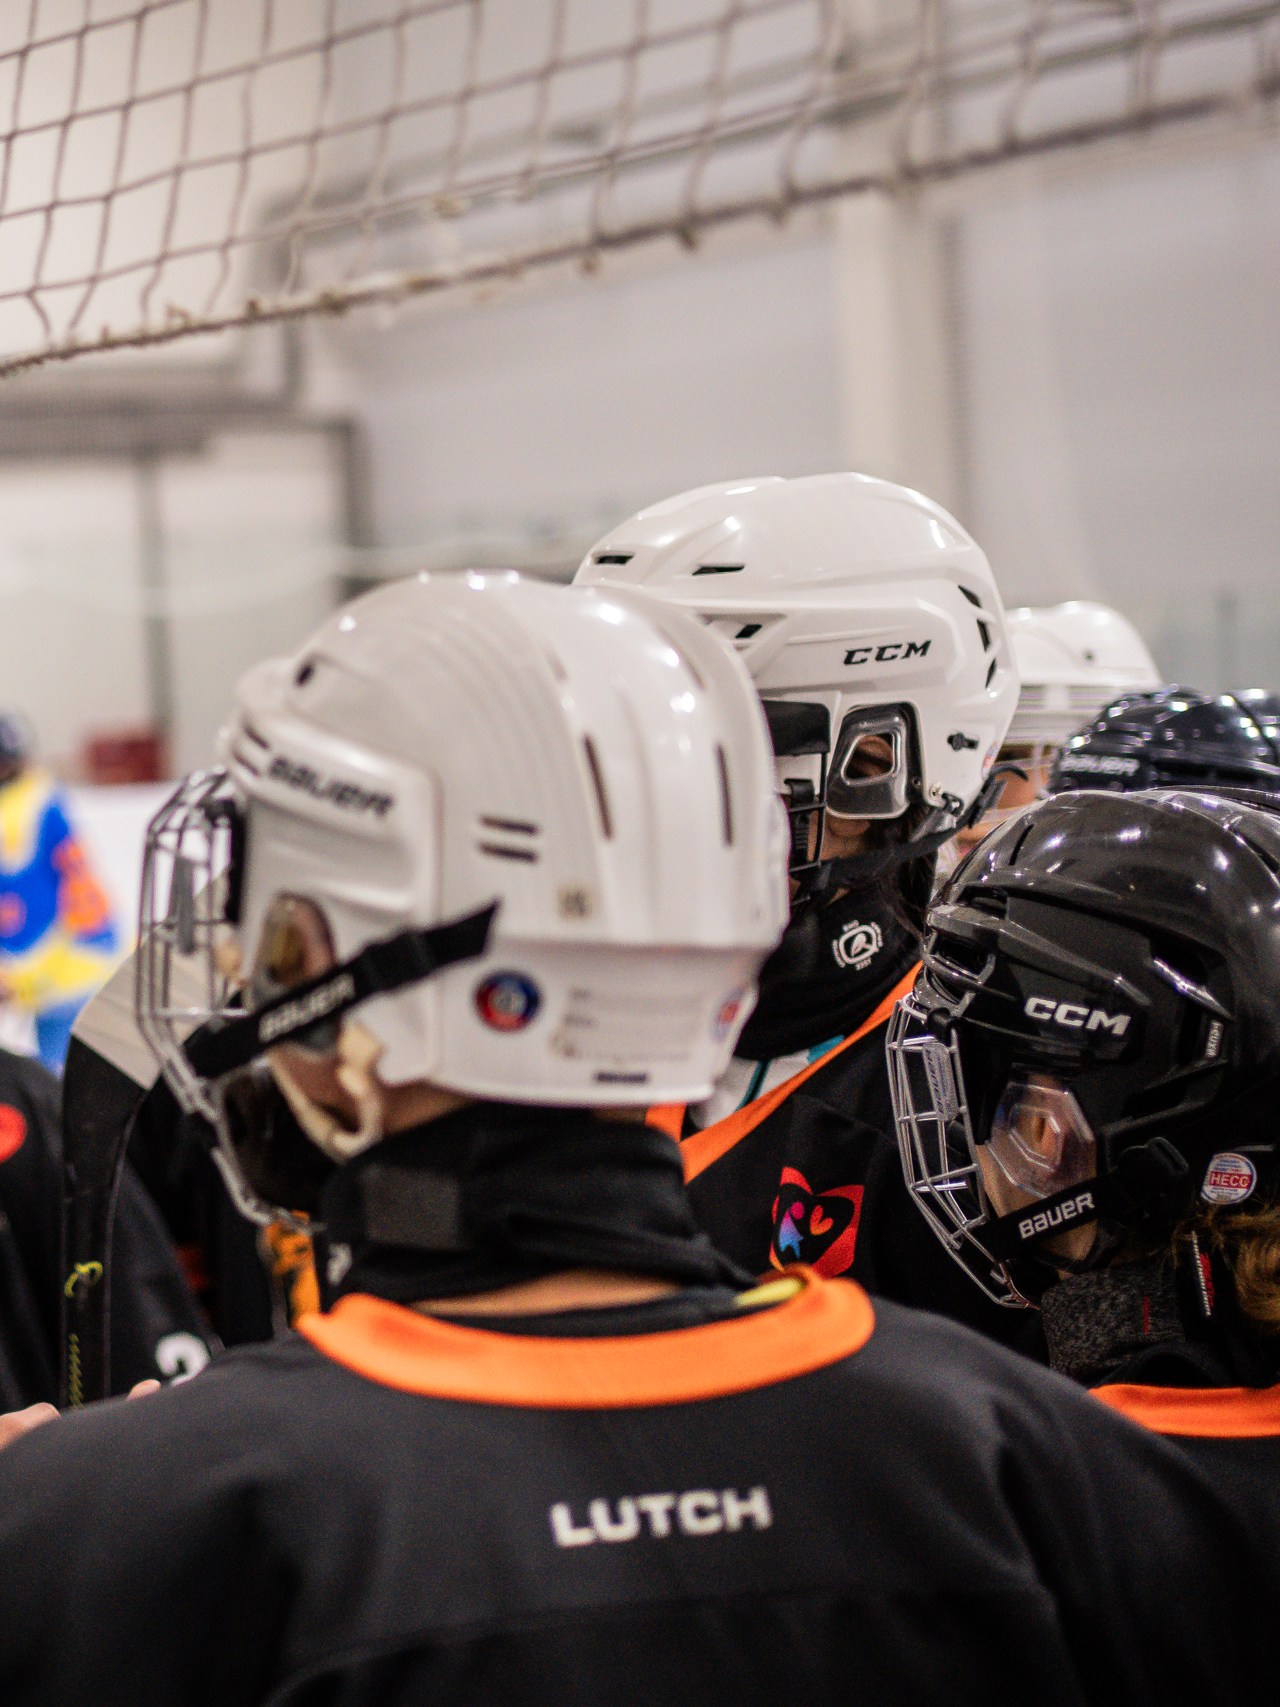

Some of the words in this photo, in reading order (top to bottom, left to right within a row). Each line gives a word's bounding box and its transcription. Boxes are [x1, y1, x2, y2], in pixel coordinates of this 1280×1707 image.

[843, 639, 931, 666] CCM
[1024, 997, 1131, 1036] CCM
[1210, 1171, 1251, 1187] HECC
[549, 1484, 774, 1548] LUTCH
